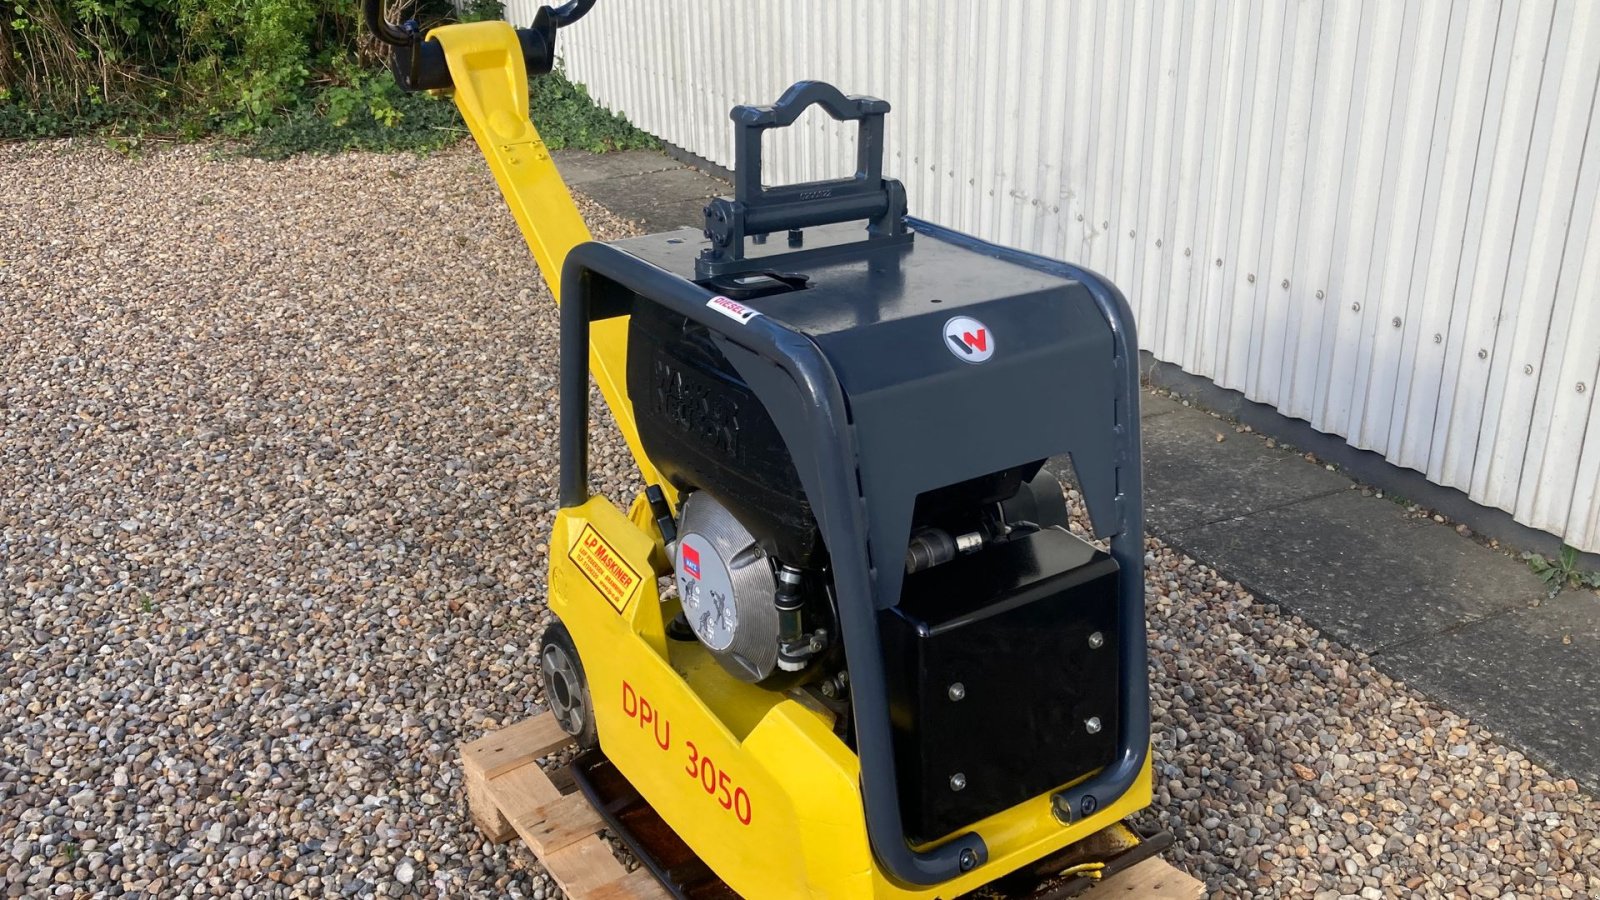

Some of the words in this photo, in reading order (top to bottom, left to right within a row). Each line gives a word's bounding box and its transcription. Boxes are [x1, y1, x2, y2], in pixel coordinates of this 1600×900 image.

[714, 297, 746, 314] DIESEL
[583, 533, 598, 549] LP
[594, 544, 633, 588] MASKINER
[622, 680, 670, 751] DPU
[685, 741, 752, 825] 3050
